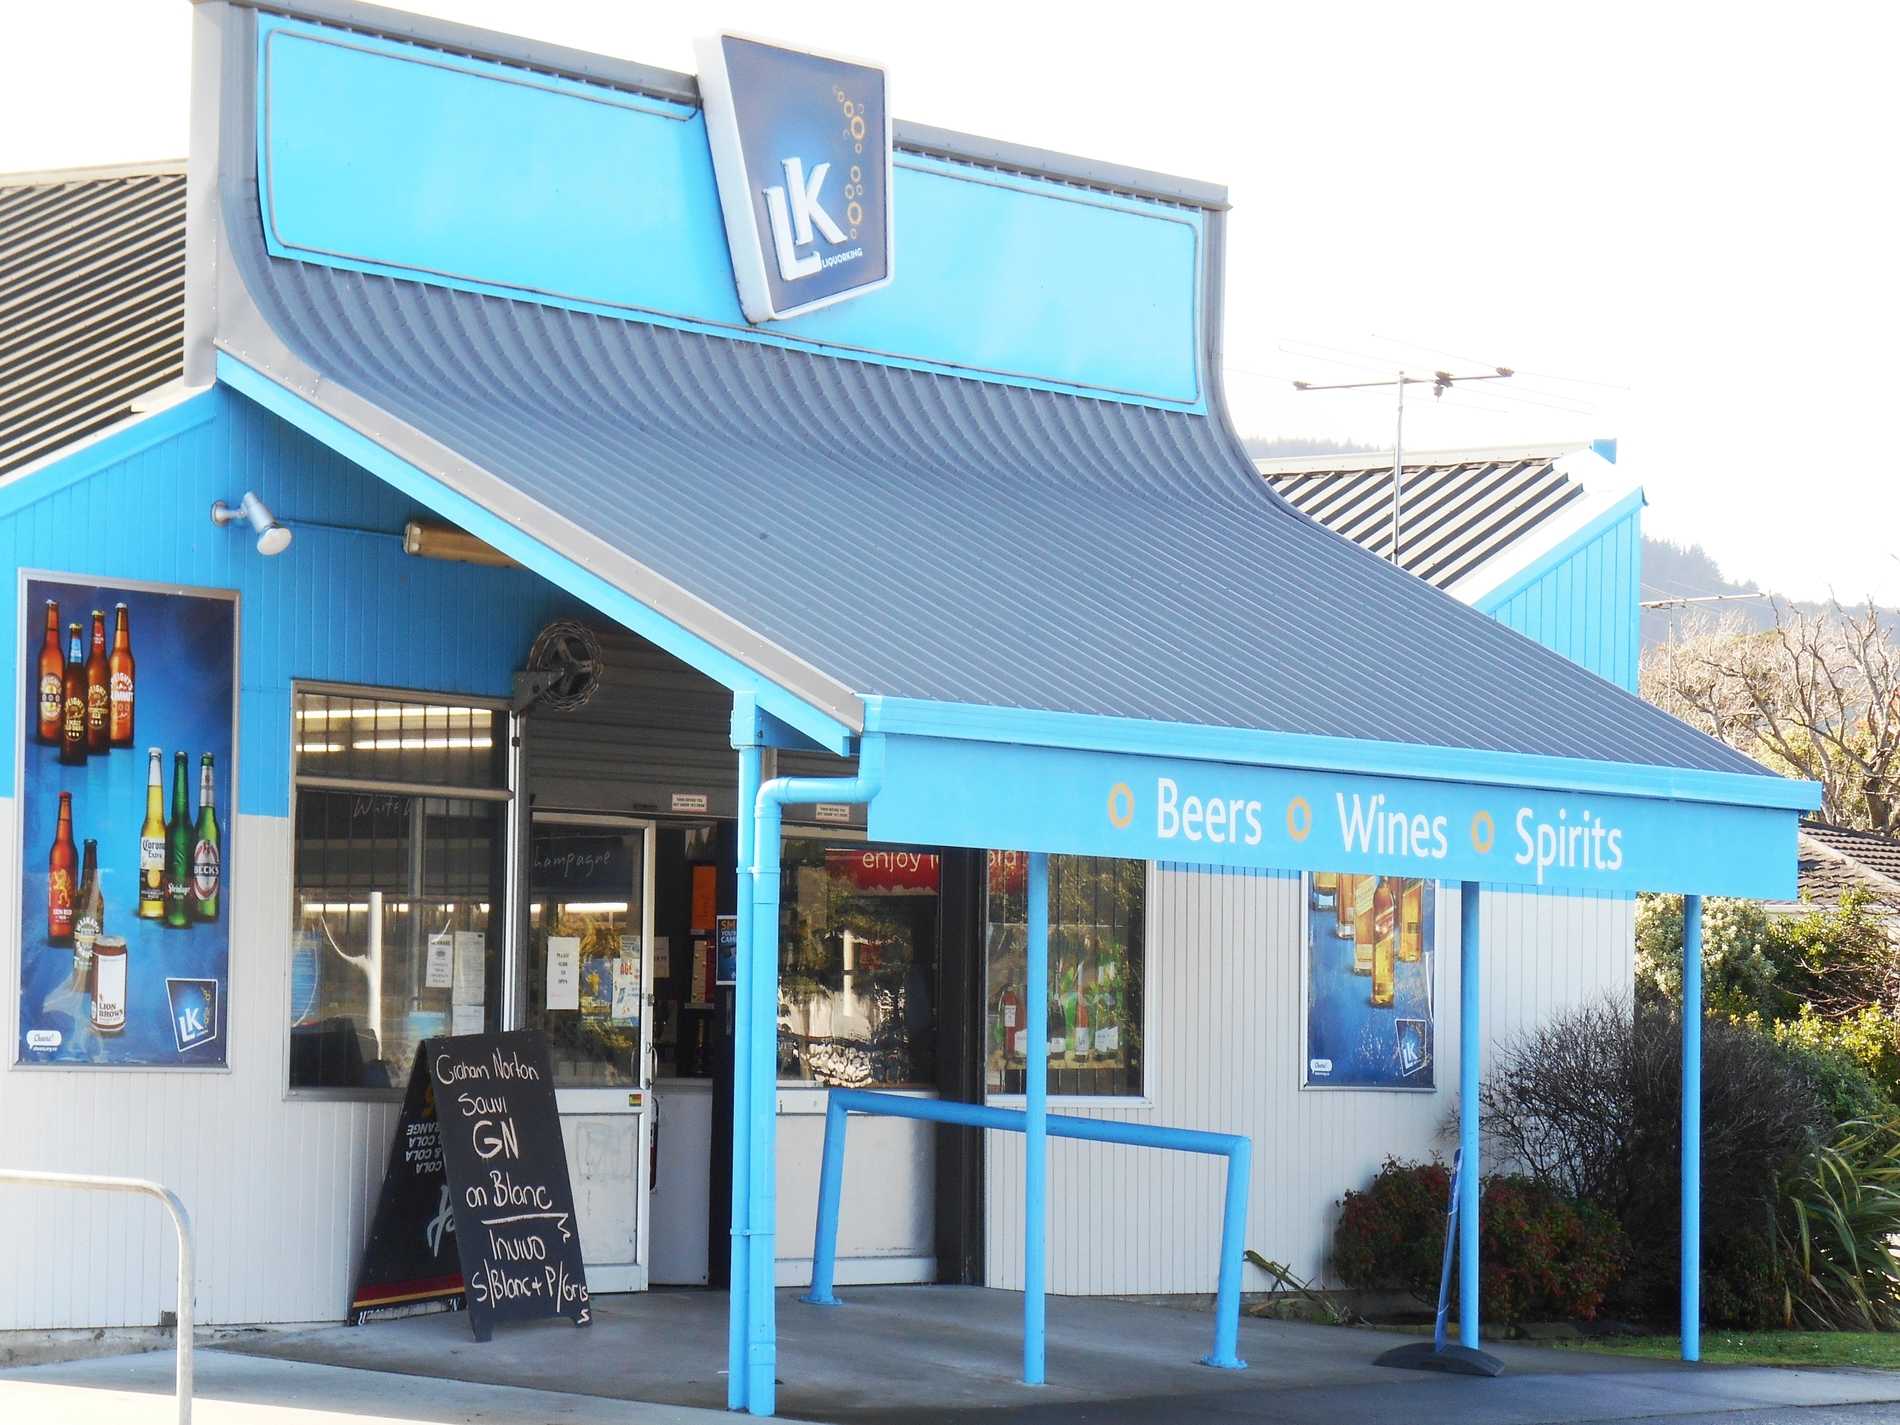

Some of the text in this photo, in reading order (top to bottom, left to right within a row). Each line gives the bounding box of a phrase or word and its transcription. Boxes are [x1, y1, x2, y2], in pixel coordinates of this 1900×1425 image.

[762, 157, 849, 281] LK
[1157, 777, 1624, 885] Beers Wines Spirits
[862, 851, 921, 872] enjoy
[436, 1047, 540, 1084] Graham Norton
[406, 1121, 441, 1136] RANGE
[472, 1117, 519, 1159] GN
[405, 1149, 432, 1162] COLA
[466, 1170, 552, 1210] on Blanc
